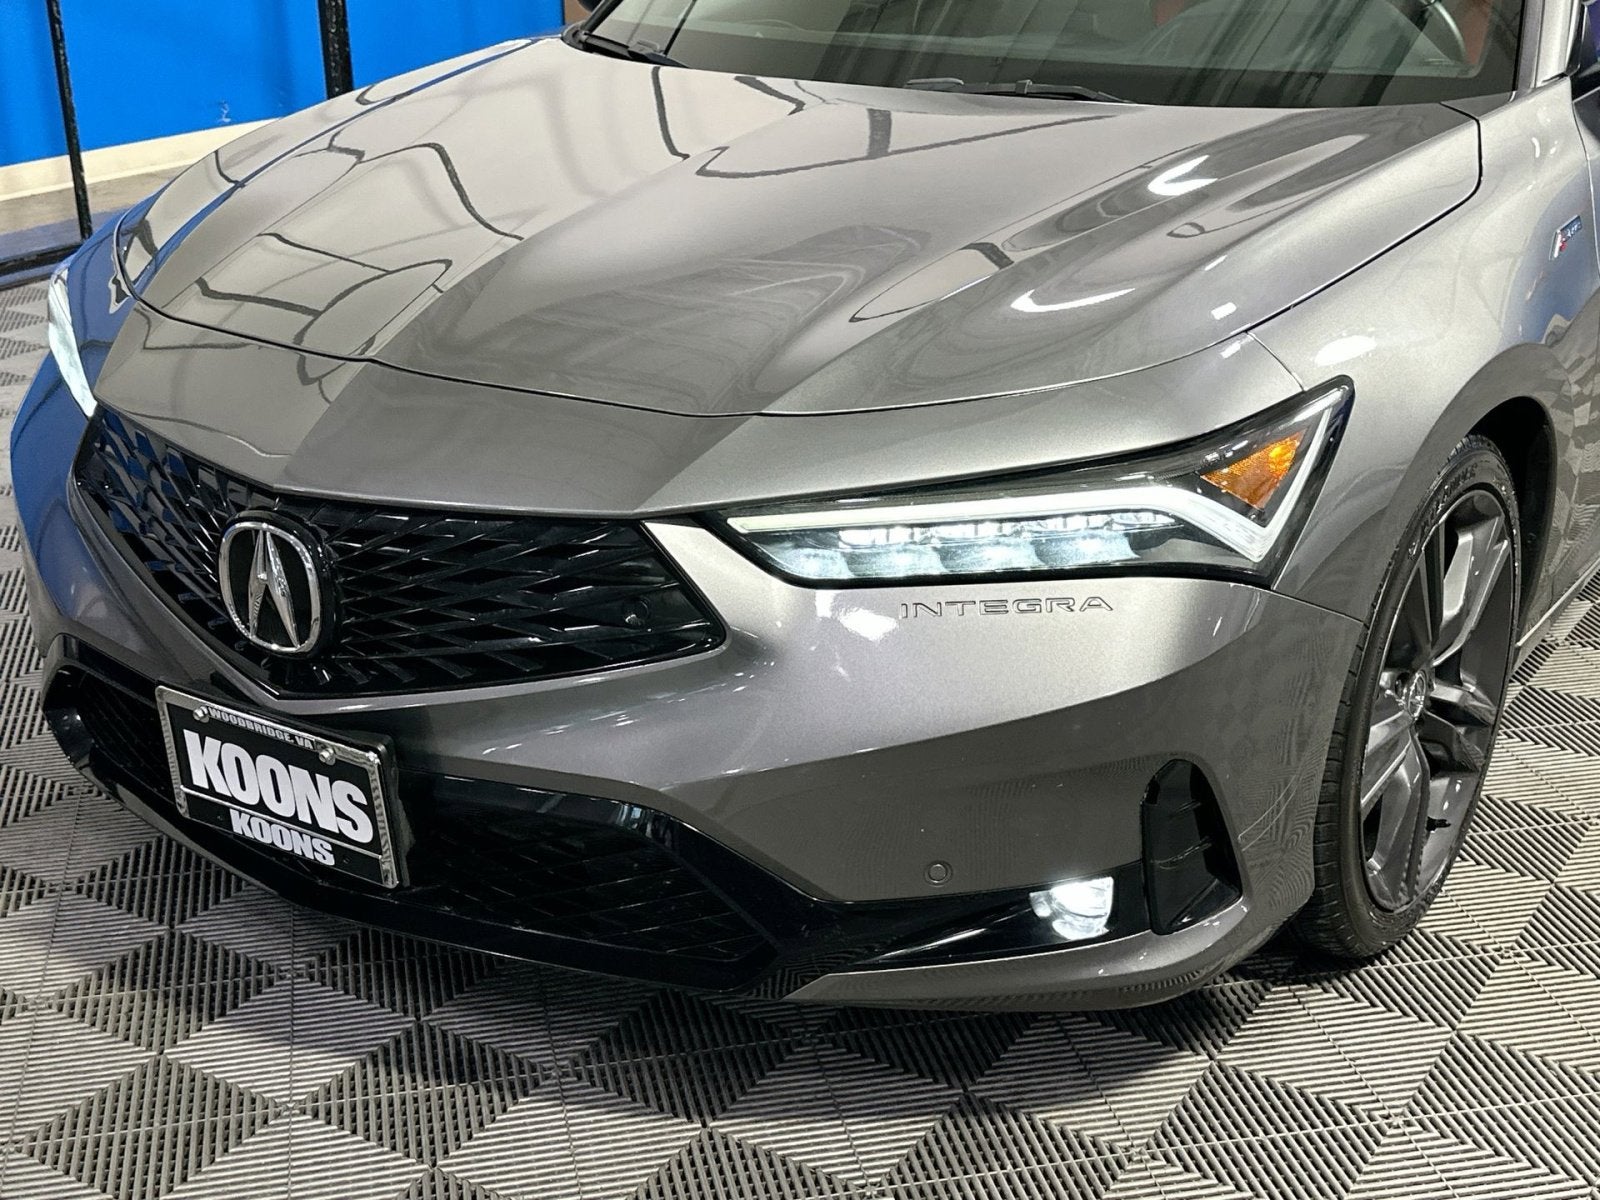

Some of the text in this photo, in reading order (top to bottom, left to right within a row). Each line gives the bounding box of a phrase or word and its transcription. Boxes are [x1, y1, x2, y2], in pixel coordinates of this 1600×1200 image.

[900, 596, 1113, 619] INTEGRA
[294, 735, 314, 750] VA
[183, 729, 373, 843] KOONS
[230, 808, 335, 865] KOONS
